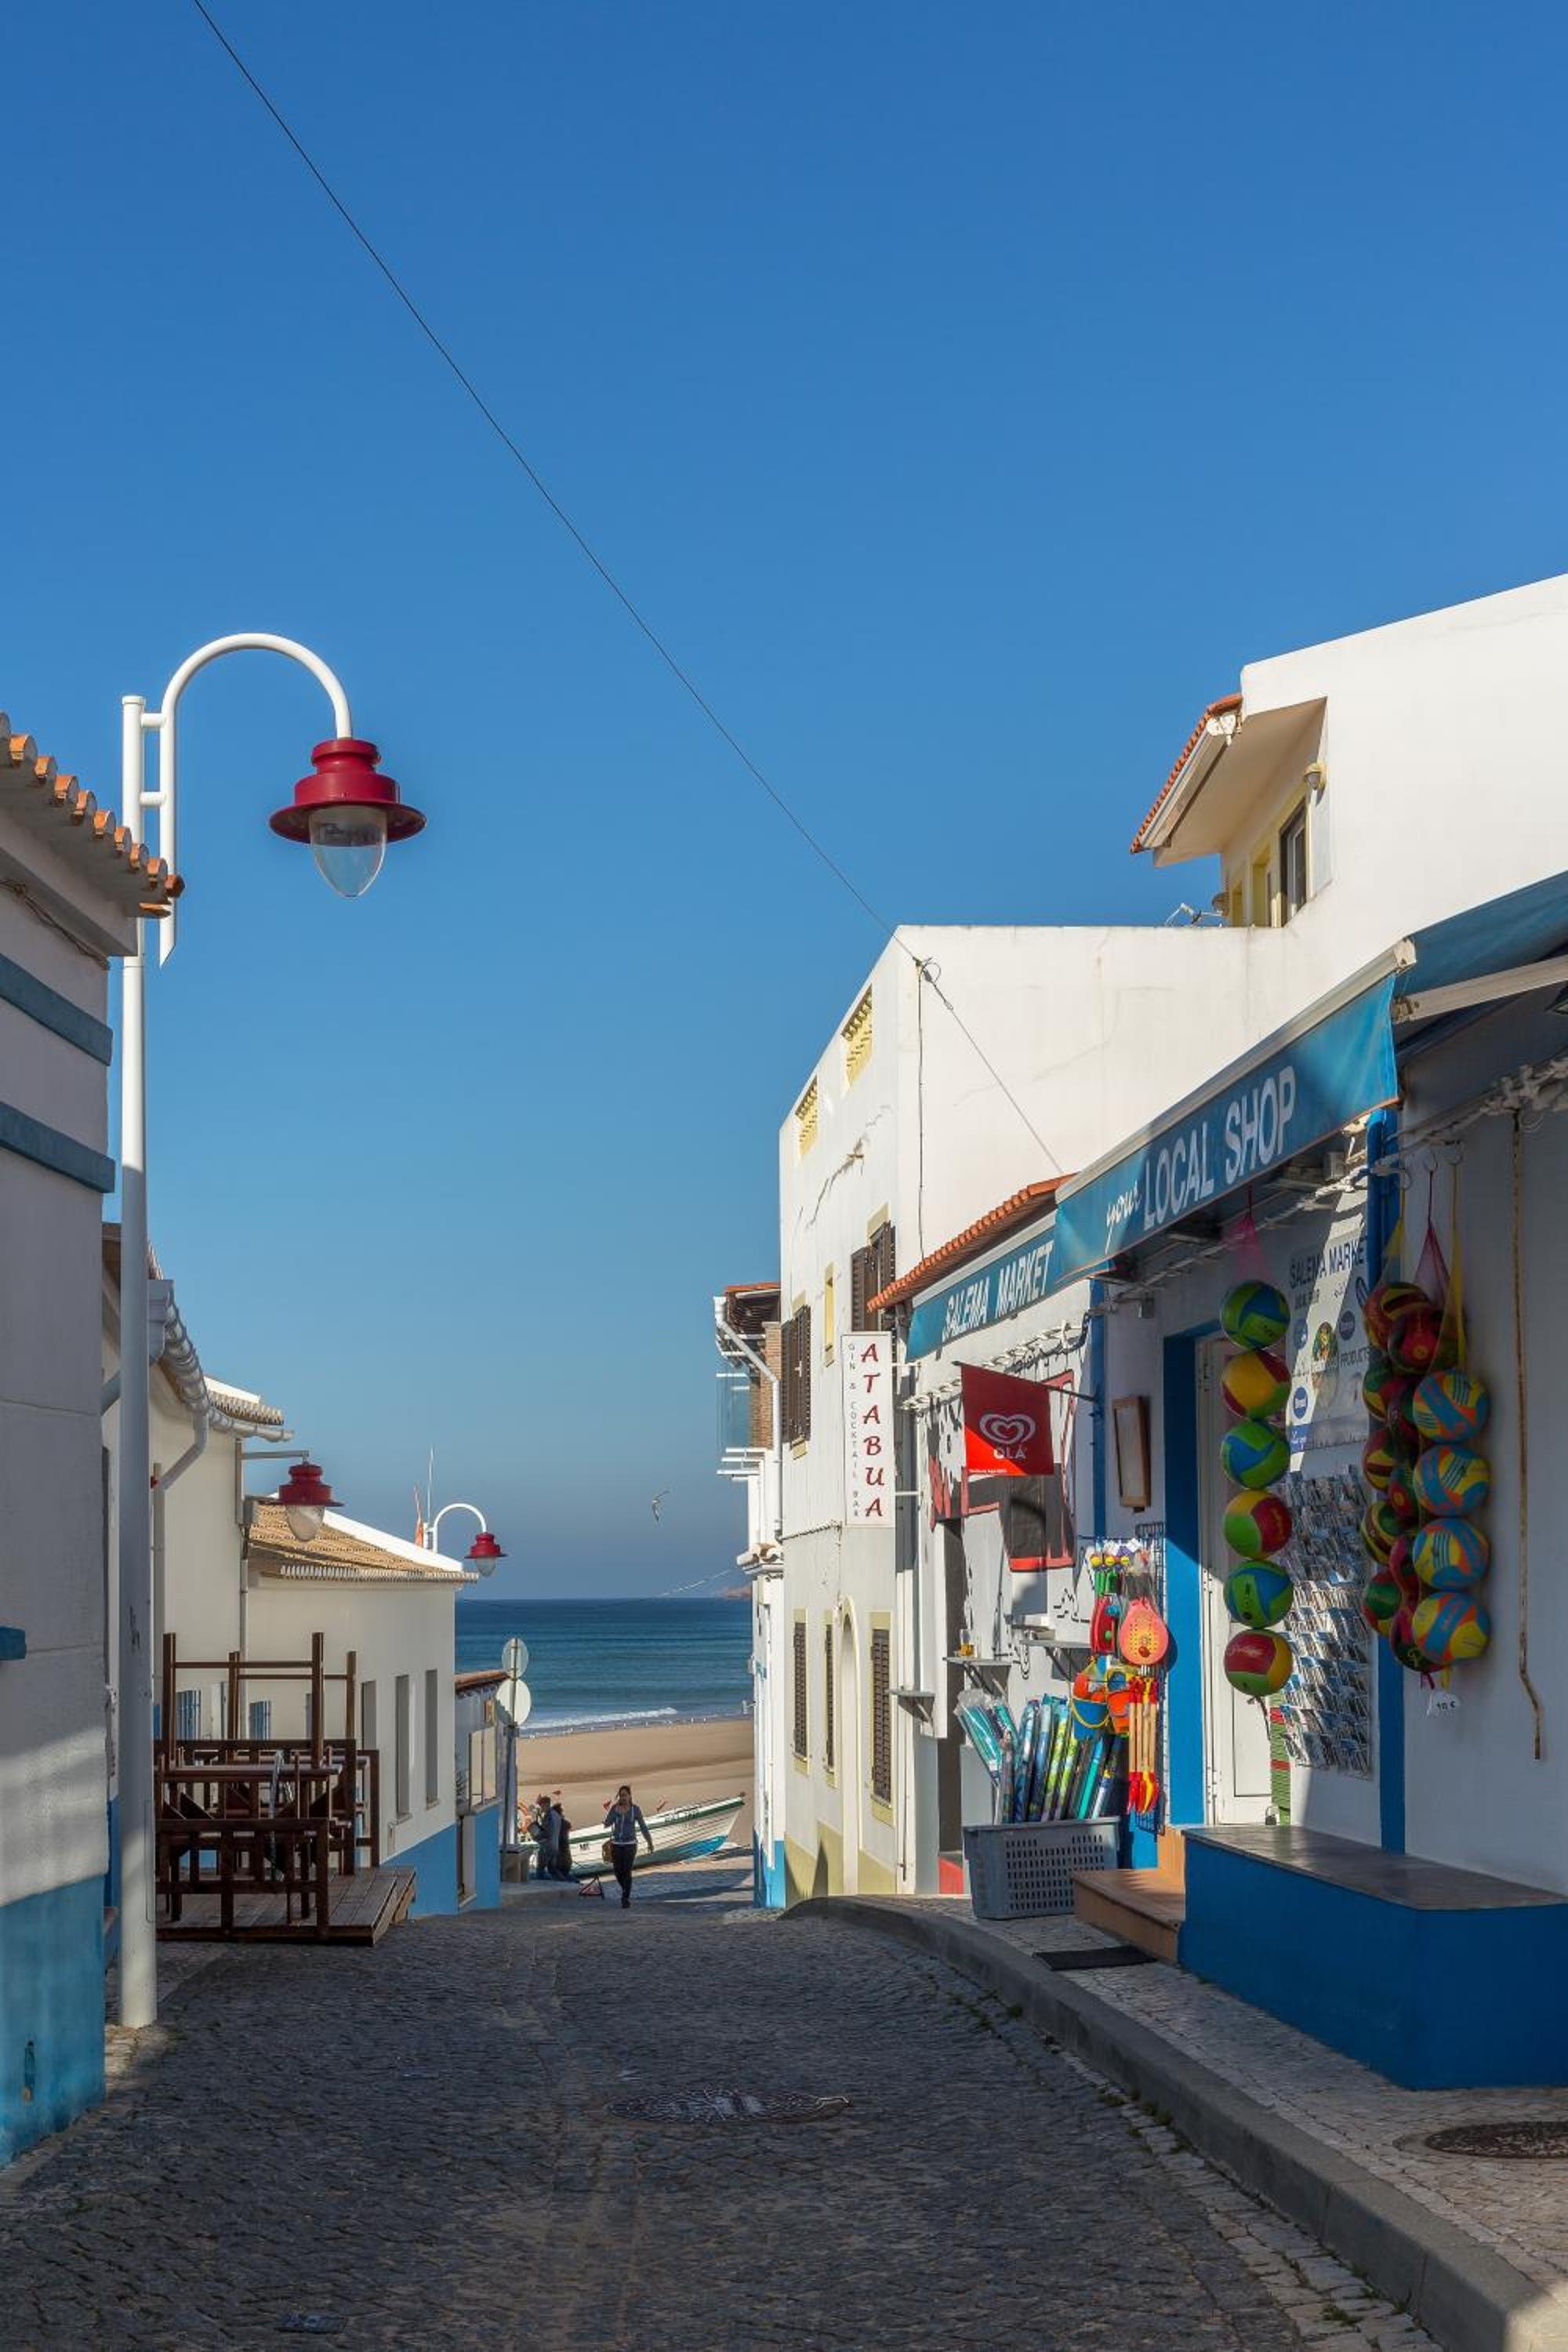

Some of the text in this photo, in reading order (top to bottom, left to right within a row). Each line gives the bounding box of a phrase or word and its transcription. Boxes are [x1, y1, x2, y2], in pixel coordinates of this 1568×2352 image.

[1144, 1122, 1214, 1231] LOCAL
[1225, 1065, 1296, 1184] SHOP
[942, 1242, 1053, 1341] SALEMA MARKET
[1290, 1236, 1367, 1288] SALEMA MARKE
[850, 1401, 858, 1479] COCKTAIL
